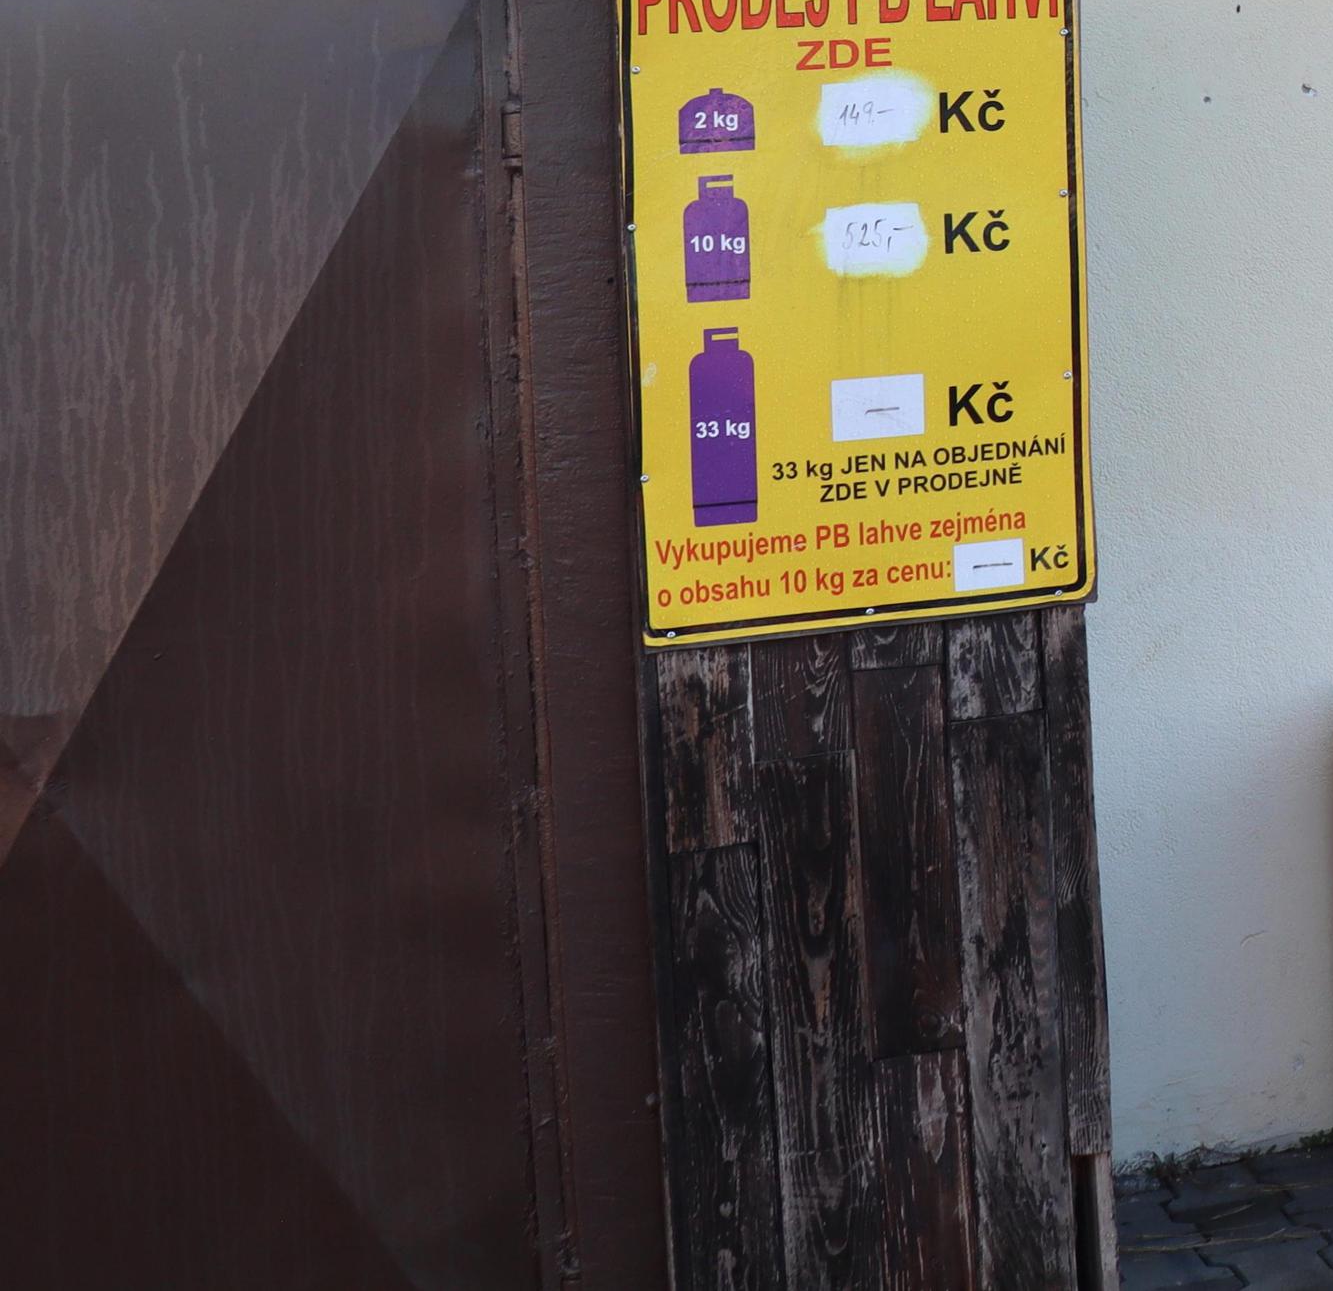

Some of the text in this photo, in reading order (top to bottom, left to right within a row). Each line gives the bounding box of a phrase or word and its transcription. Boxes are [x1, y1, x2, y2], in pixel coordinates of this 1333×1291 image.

[795, 37, 893, 71] ZDE
[694, 110, 739, 131] 2 kg
[938, 89, 1006, 133] Kč
[690, 234, 746, 255] 10 kg
[943, 209, 1010, 255] Kč
[948, 381, 1014, 427] Kč
[695, 420, 751, 440] 33 kg
[772, 433, 1066, 481] 33 kg JEN NA OBJEDNÁNÍ
[820, 463, 1022, 503] ZDE V PRODEJNĚ
[655, 510, 1026, 570] Vykupujeme PB lahve zejména
[657, 544, 1069, 608] o obsahu 10 kg za cenu: Kč
